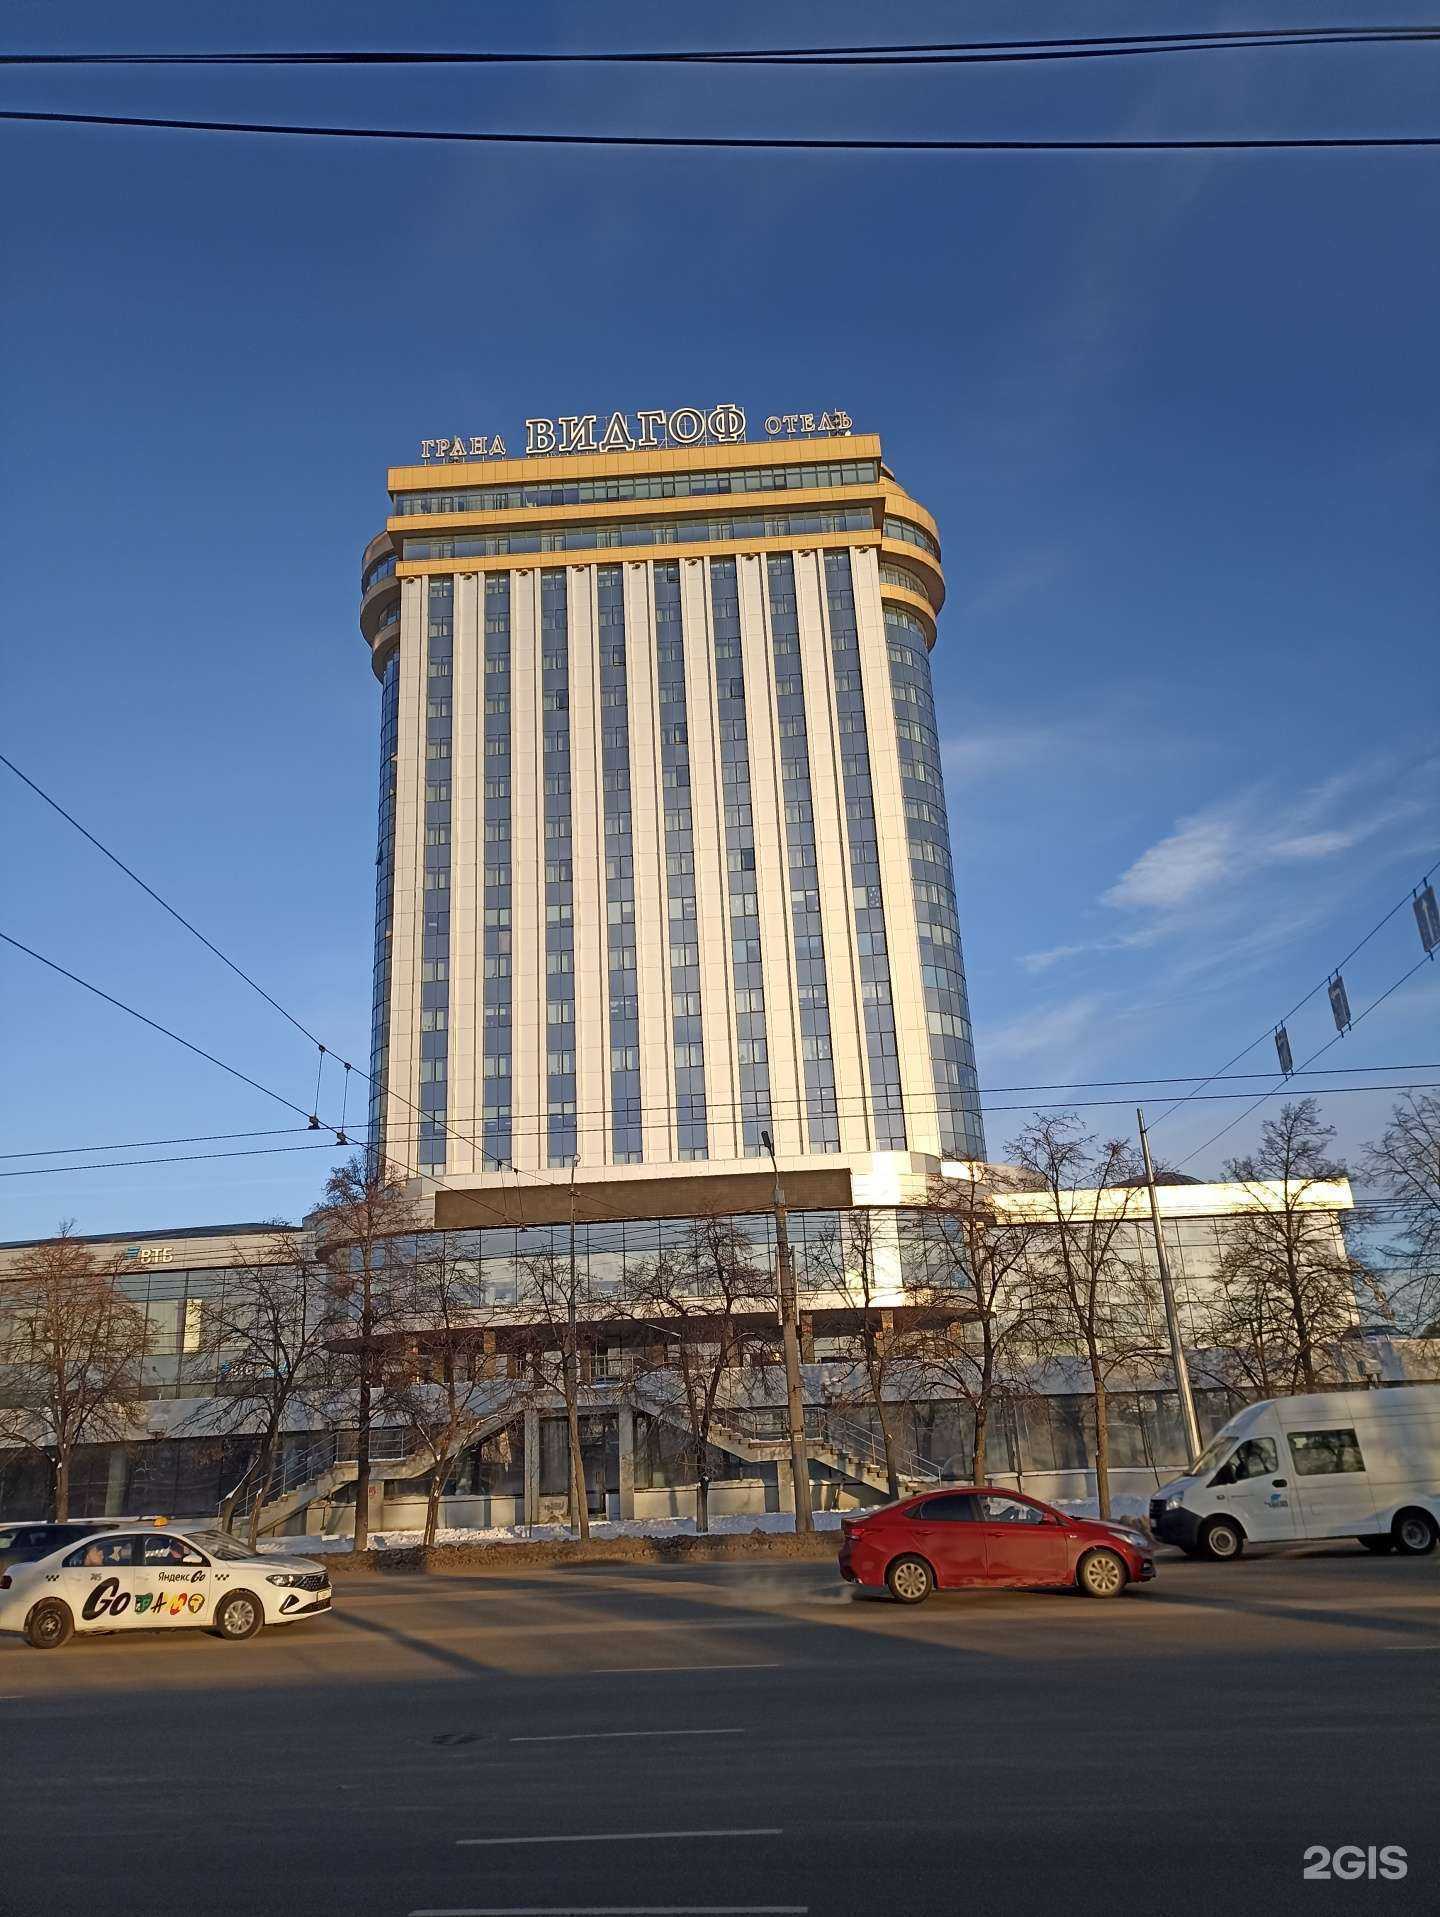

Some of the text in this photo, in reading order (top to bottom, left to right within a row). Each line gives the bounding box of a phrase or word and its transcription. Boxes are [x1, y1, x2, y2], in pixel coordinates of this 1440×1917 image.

[421, 404, 852, 457] ГРАНД ВИДГОФ ОТЕЛЬ
[141, 1247, 173, 1263] ВТБ
[158, 1570, 206, 1583] Яндекс Go
[82, 1577, 131, 1620] Go
